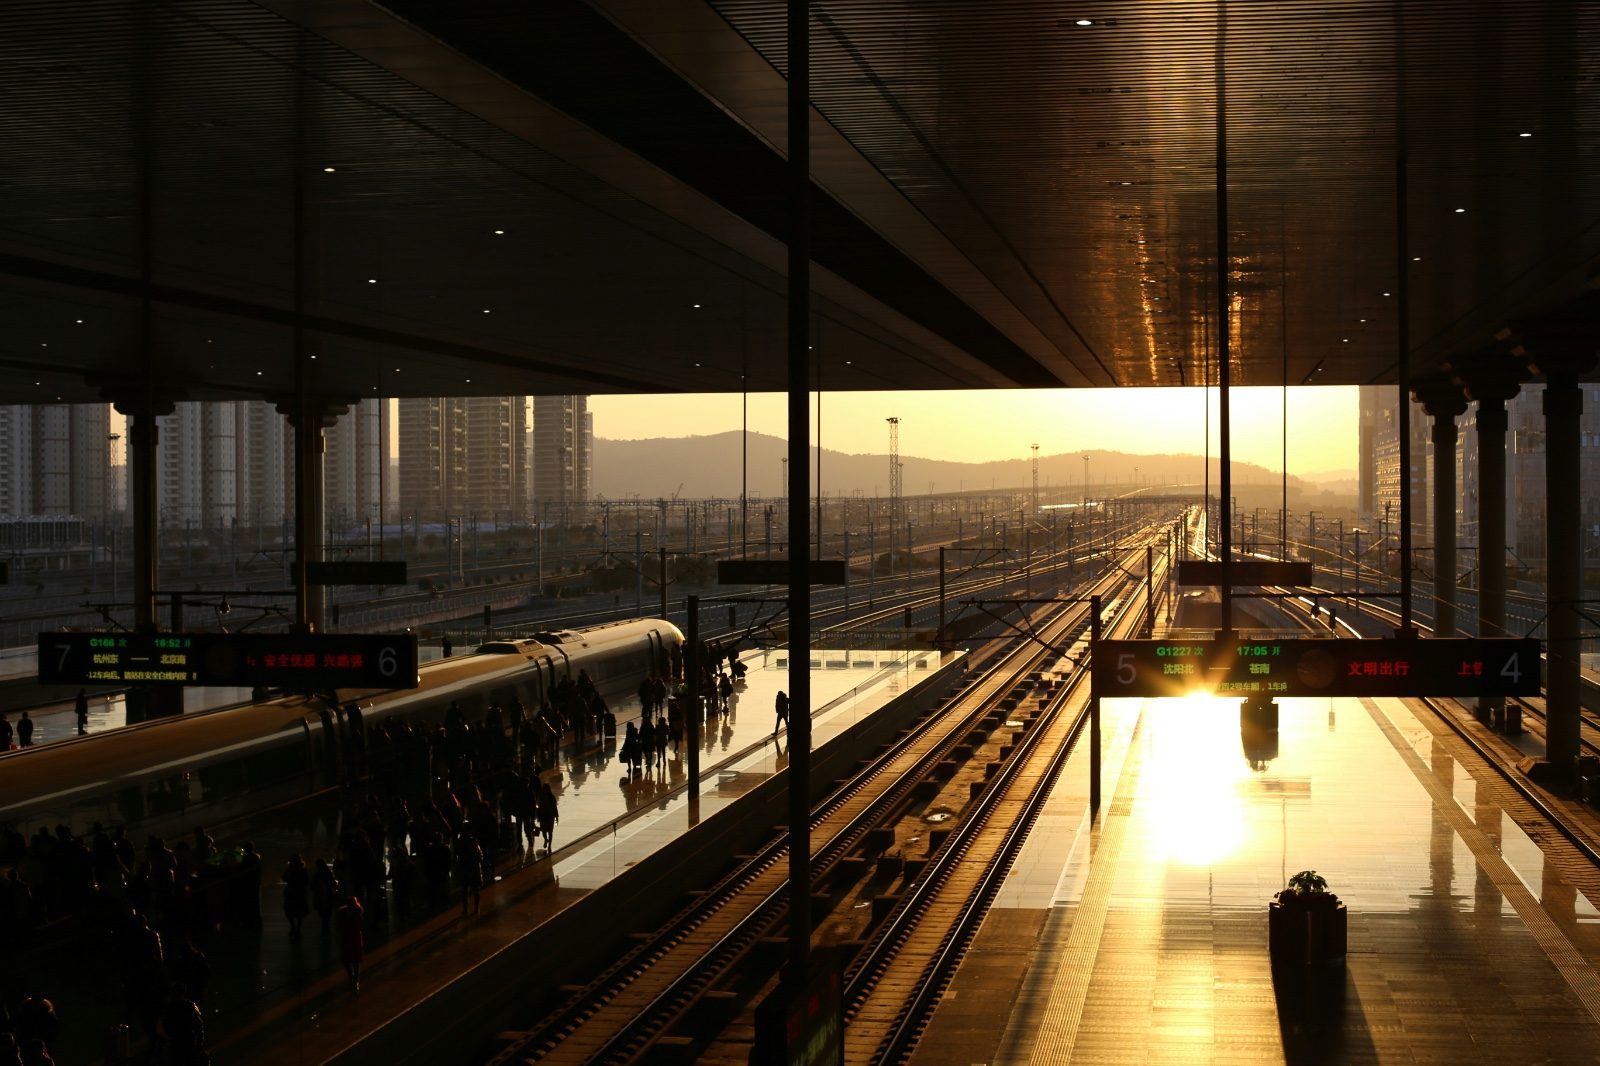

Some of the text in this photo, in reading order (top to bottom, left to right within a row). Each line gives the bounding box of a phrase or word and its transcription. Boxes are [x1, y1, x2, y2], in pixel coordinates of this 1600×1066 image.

[54, 644, 72, 672] 7
[92, 653, 187, 665] 杭州东 北京南
[379, 646, 398, 677] 6
[1156, 646, 1281, 657] G1227 次 17:05 开
[1116, 654, 1137, 685] 5
[1163, 663, 1271, 675] 沈阳北 苍南
[1347, 661, 1411, 676] 文明出行
[1499, 652, 1523, 684] 4
